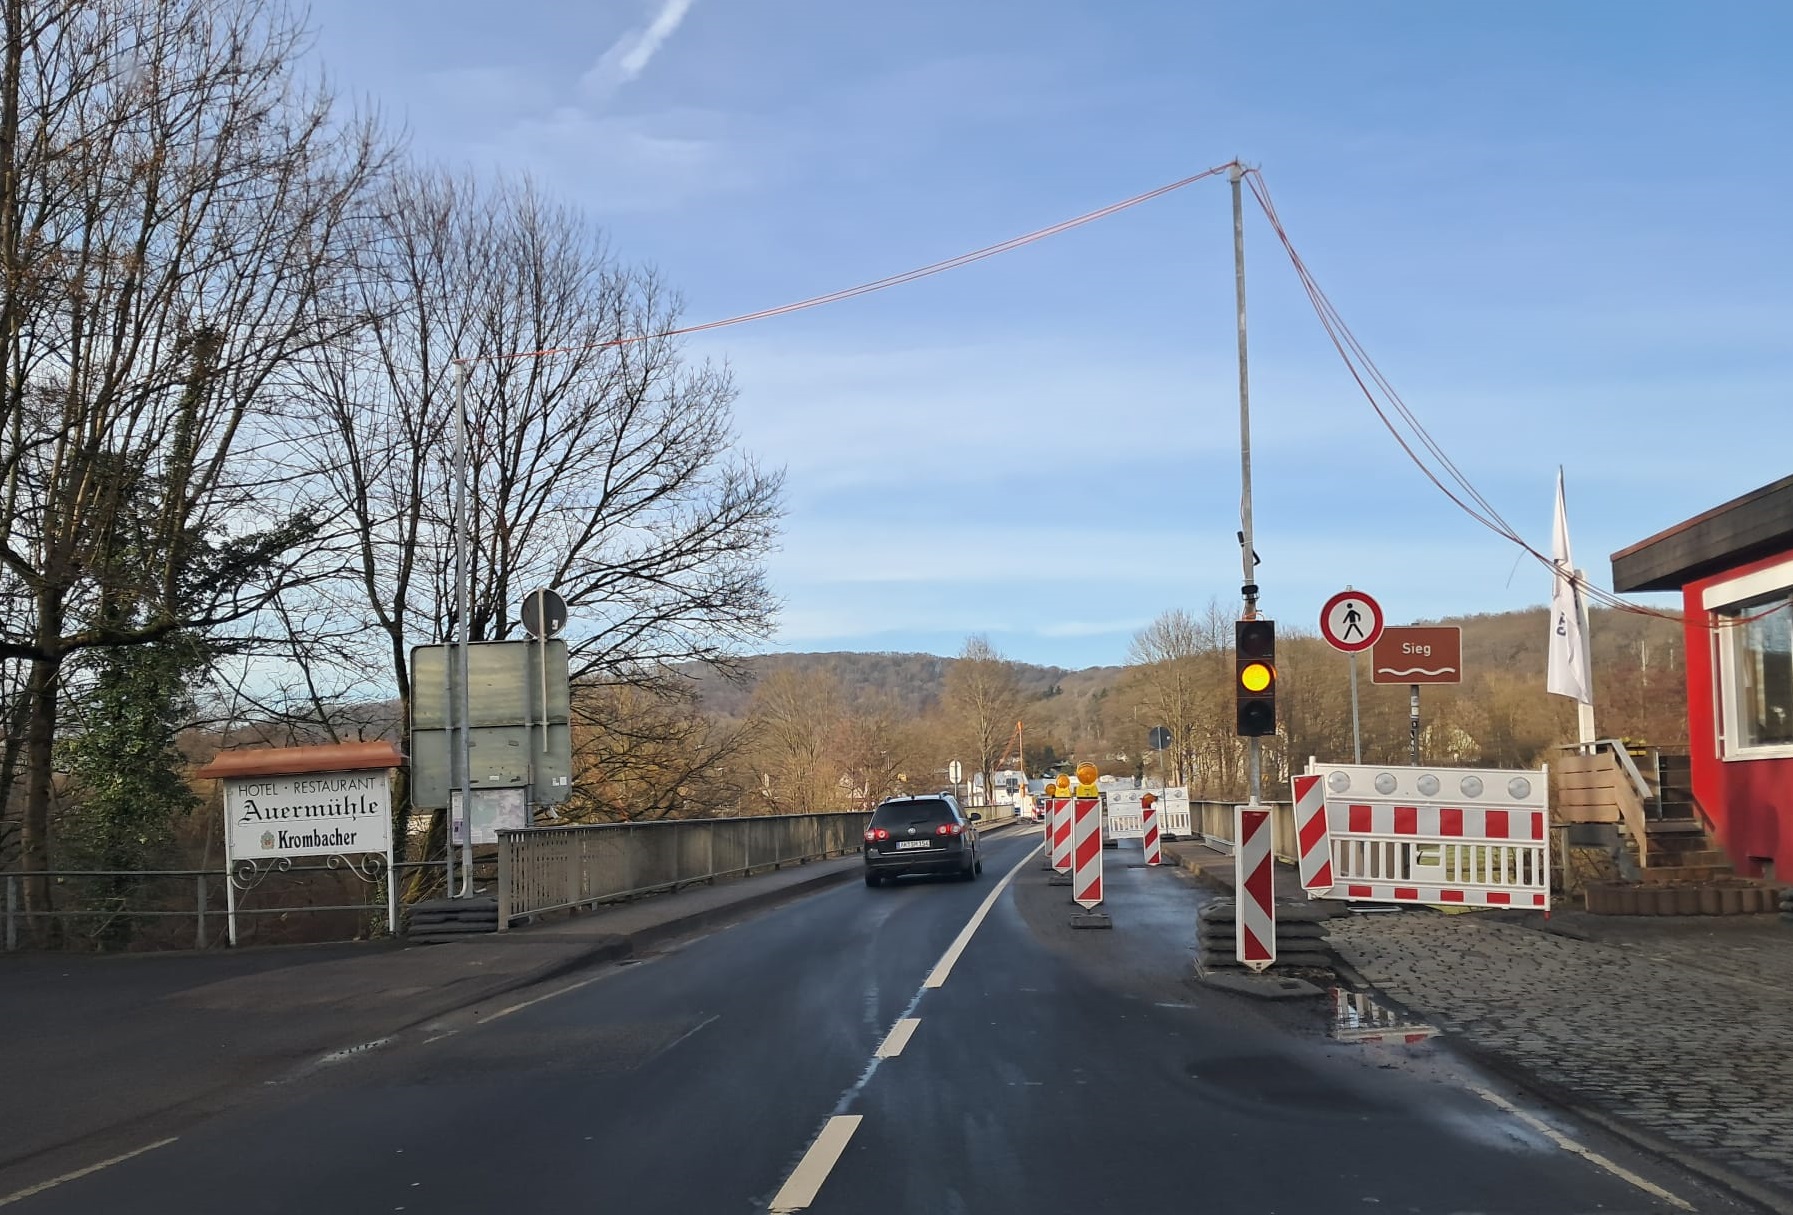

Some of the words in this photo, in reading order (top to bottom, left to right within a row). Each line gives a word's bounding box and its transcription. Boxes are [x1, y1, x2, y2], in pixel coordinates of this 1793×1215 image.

[1402, 642, 1431, 657] Sieg
[238, 783, 278, 797] HOTEL
[294, 777, 376, 794] RESTAURANT
[239, 793, 379, 822] Auermühle
[278, 828, 357, 849] Krombacher
